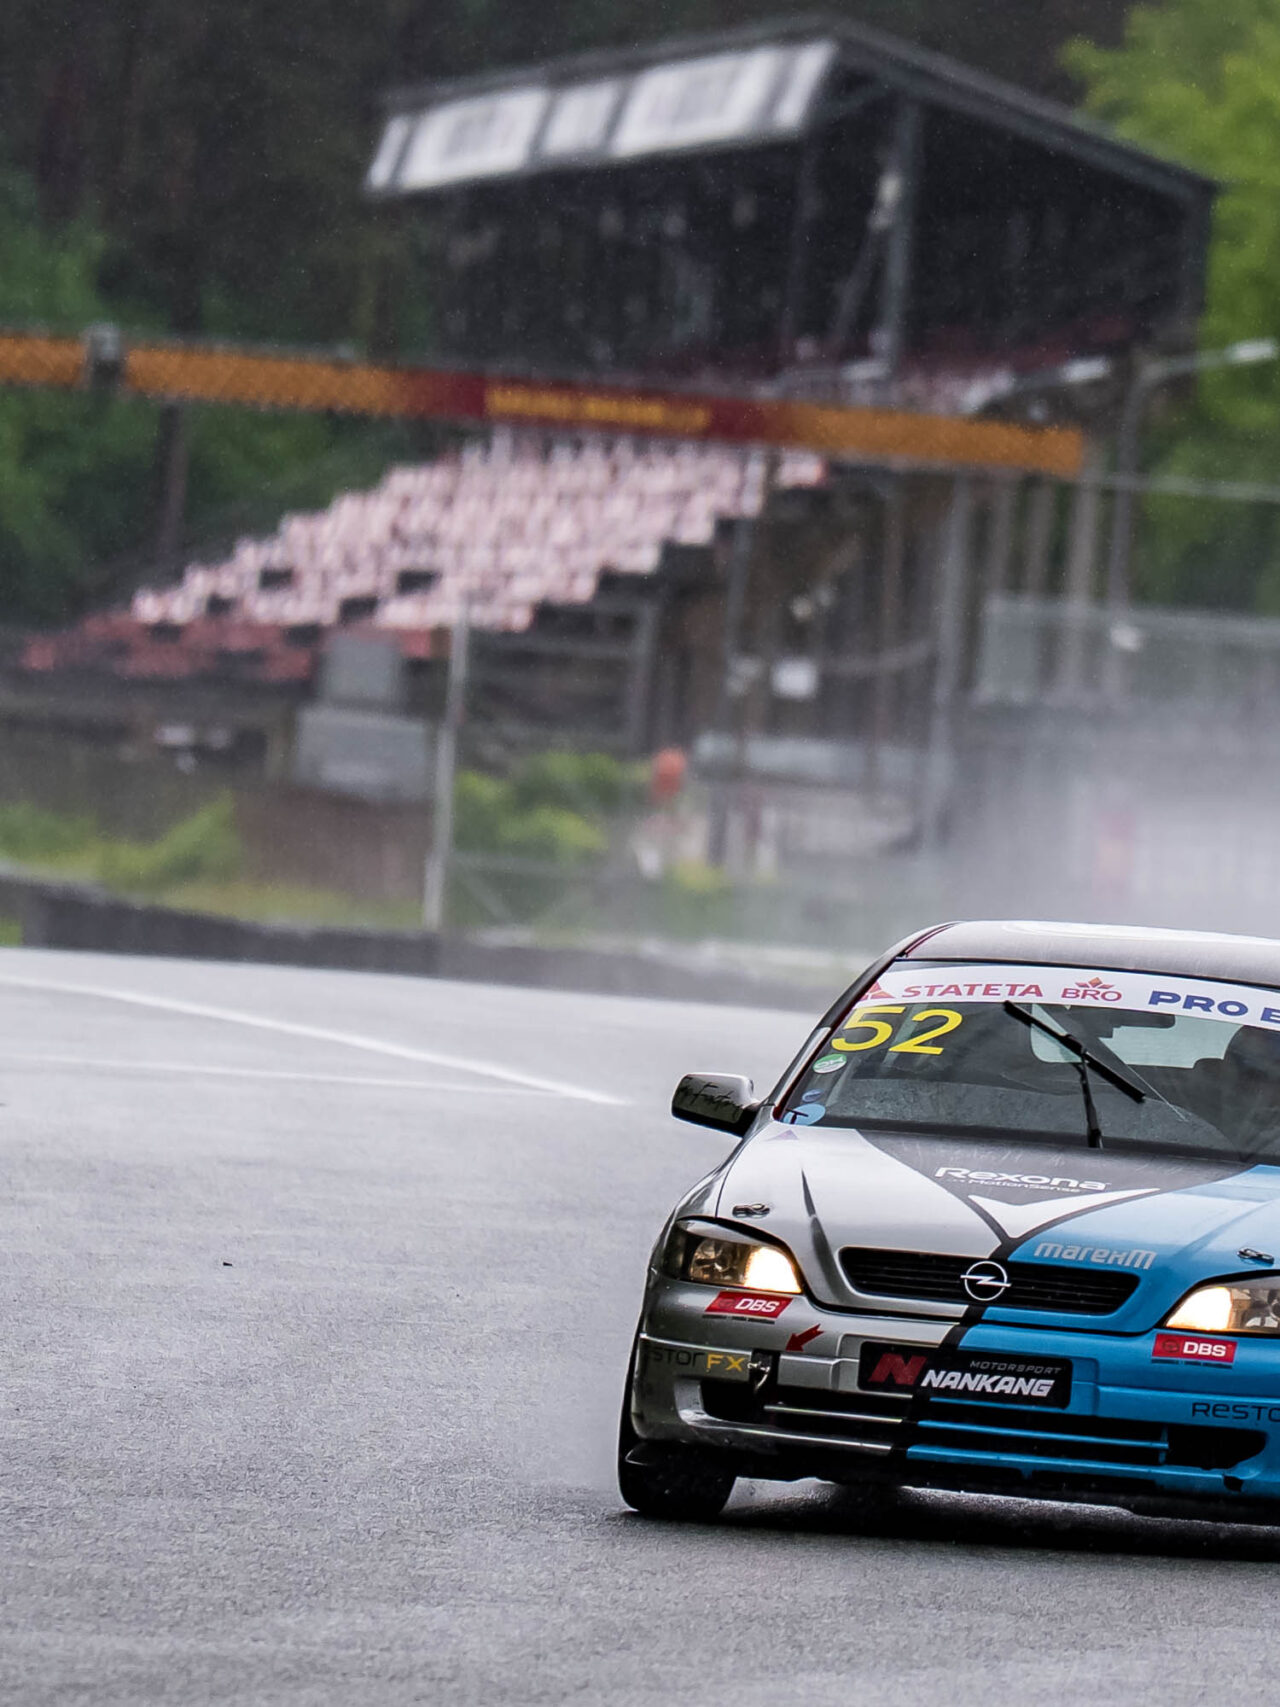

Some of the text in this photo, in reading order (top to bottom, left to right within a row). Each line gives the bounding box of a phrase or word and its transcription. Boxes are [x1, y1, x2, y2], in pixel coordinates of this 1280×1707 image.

[901, 983, 1122, 1002] STATETA BRO
[1148, 990, 1249, 1017] PRO
[831, 1006, 963, 1055] 52
[935, 1167, 1107, 1190] Rexona
[734, 1298, 780, 1313] DBS
[1183, 1341, 1227, 1357] DBS
[970, 1360, 1063, 1375] MOTORSPORT
[921, 1369, 1055, 1397] NANKANG
